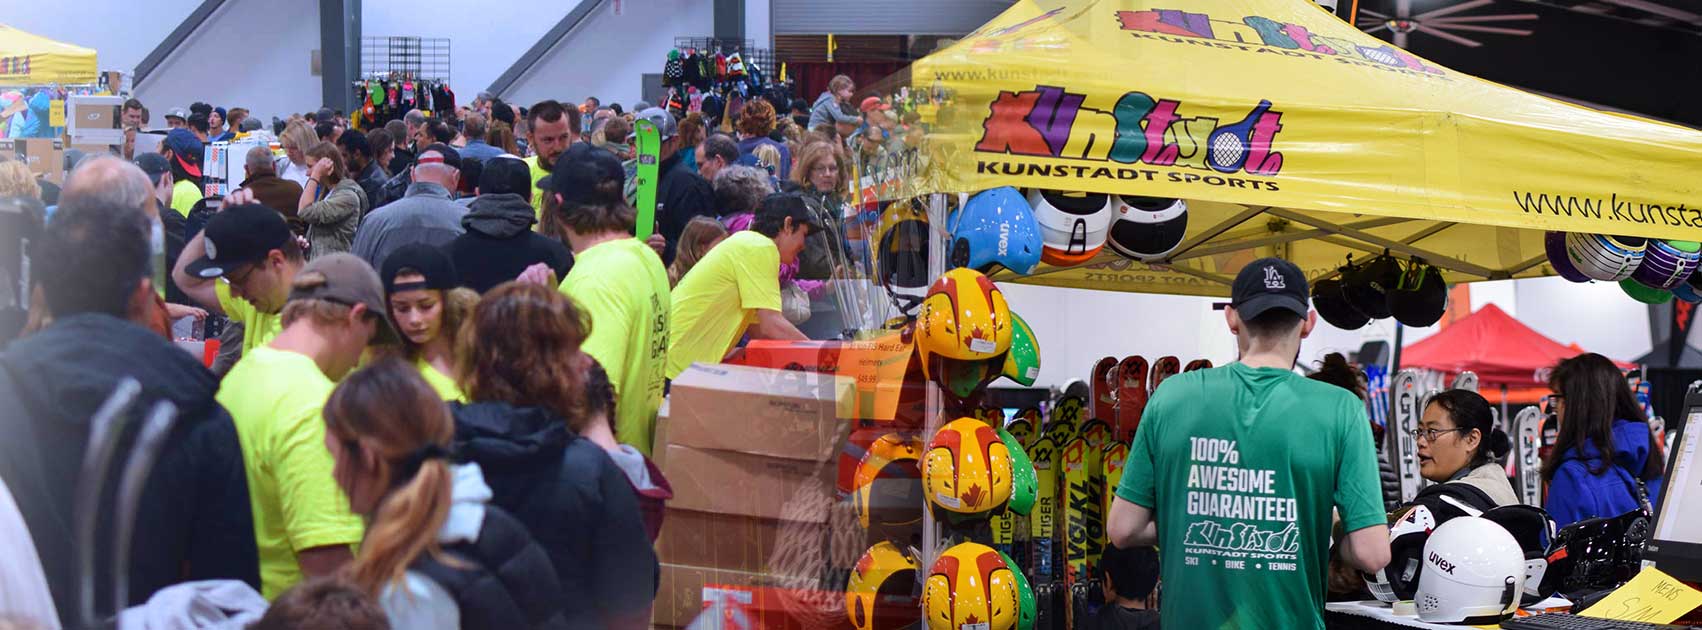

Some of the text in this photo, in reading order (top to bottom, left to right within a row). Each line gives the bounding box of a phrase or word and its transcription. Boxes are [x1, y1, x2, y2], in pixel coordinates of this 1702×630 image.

[977, 160, 1280, 192] KUNSTADT SPORTS
[998, 222, 1009, 257] uvex
[1263, 266, 1286, 289] LA
[878, 343, 894, 352] Hard
[1400, 392, 1413, 479] HEAD
[1190, 437, 1239, 464] 100%
[1187, 464, 1276, 494] AWESOME
[1040, 497, 1051, 537] TIGER
[1187, 491, 1298, 522] GUARANTEED
[1184, 556, 1297, 571] SKI BIKE TENNIS
[1185, 547, 1297, 560] KUNSTADT SPORTS
[1428, 551, 1456, 576] uvex
[1651, 579, 1684, 601] MENS
